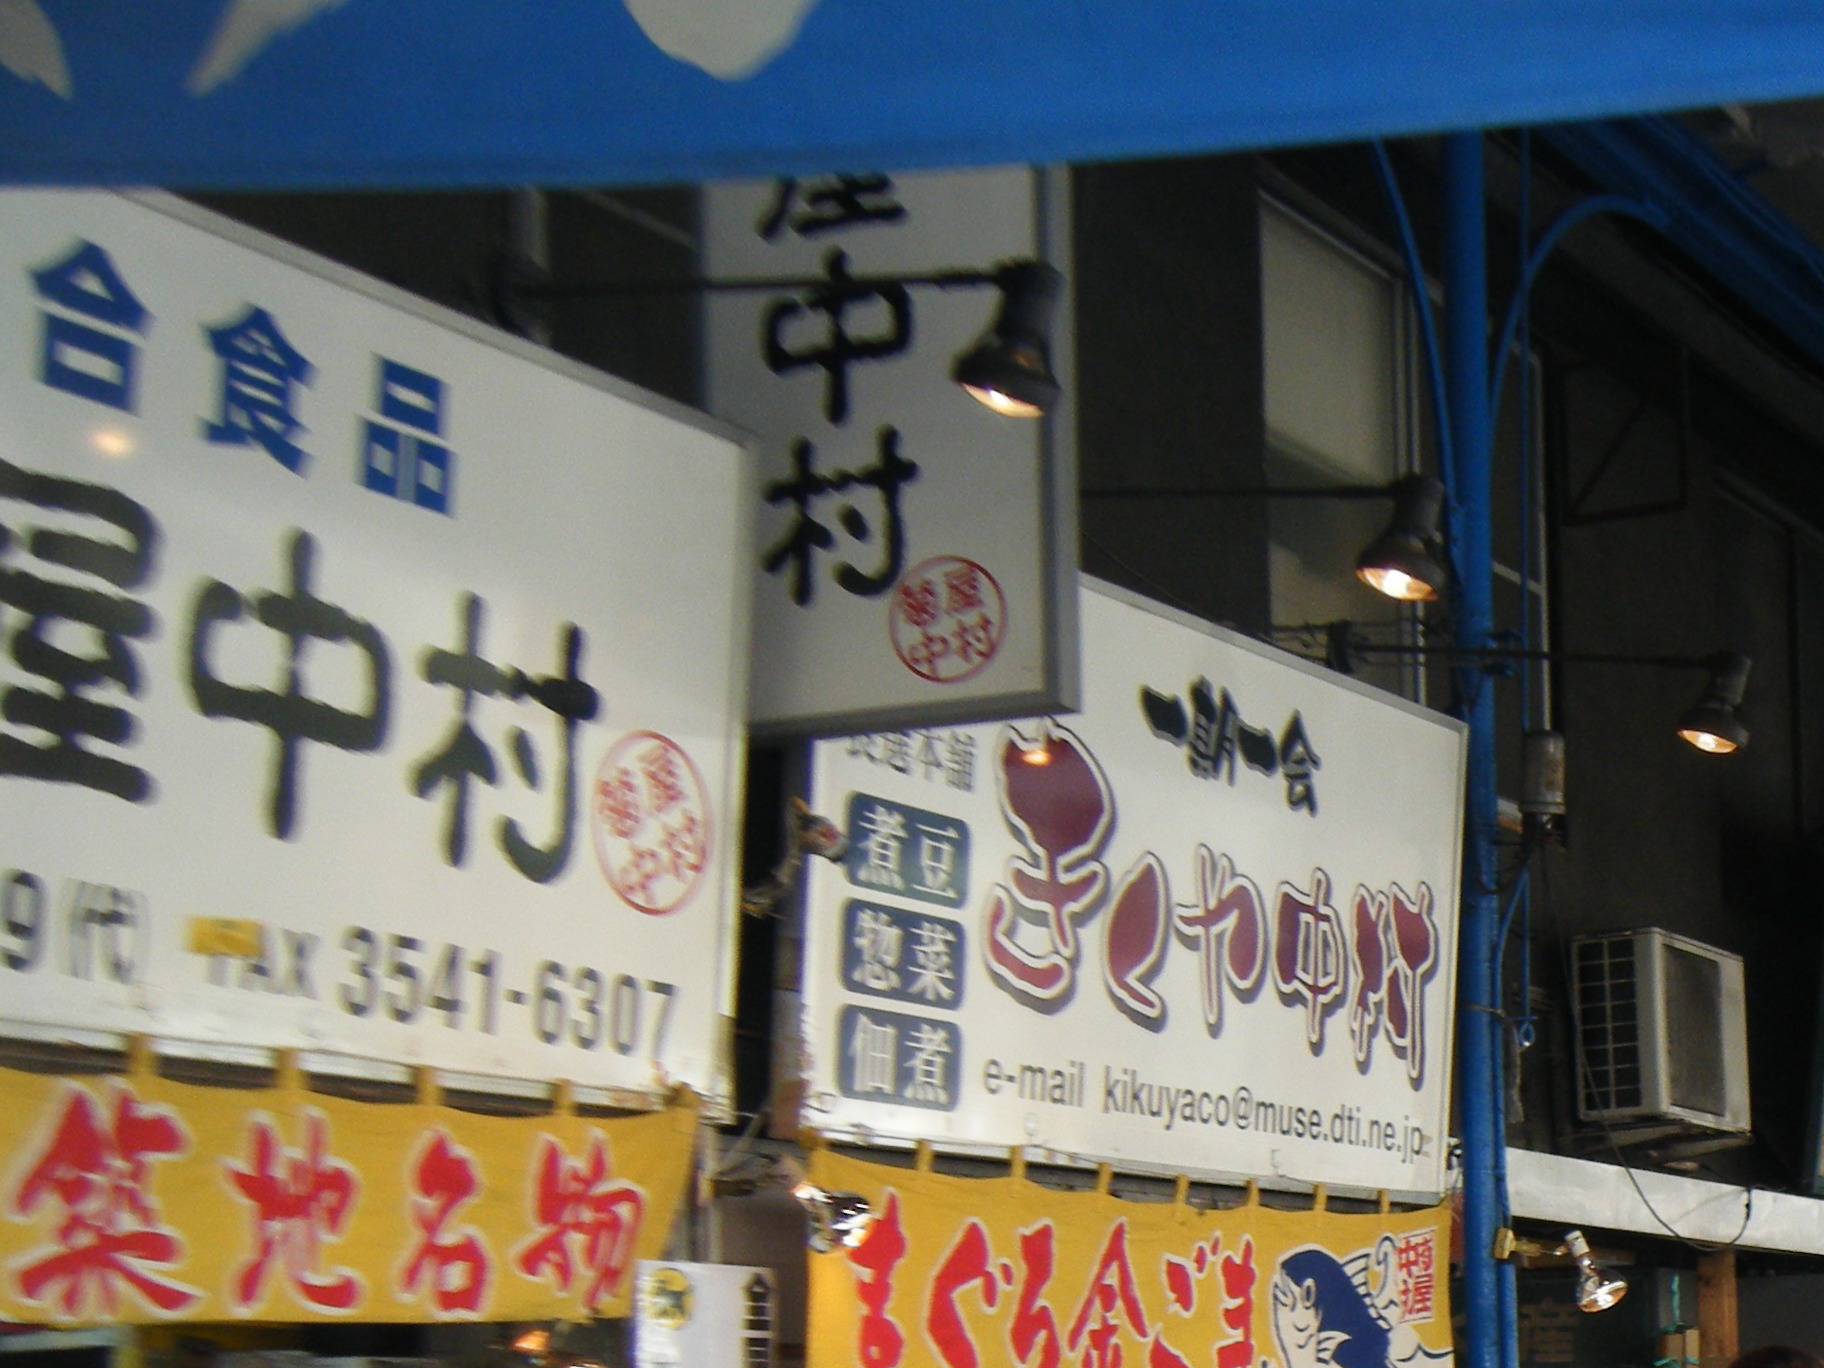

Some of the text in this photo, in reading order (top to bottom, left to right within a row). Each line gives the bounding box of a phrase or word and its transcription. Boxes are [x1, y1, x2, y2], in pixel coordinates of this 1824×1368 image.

[1140, 675, 1322, 817] 一期一会
[855, 804, 958, 901] 煮豆
[985, 720, 1434, 1086] きくや中村
[339, 925, 678, 1056] 3541-6307
[852, 906, 958, 1005] 惣菜
[848, 1010, 954, 1106] 佃煮
[984, 1055, 1425, 1164] e-mail kikuyaco@muse.dti.ne.jp
[8, 1077, 645, 1317] 築地名物
